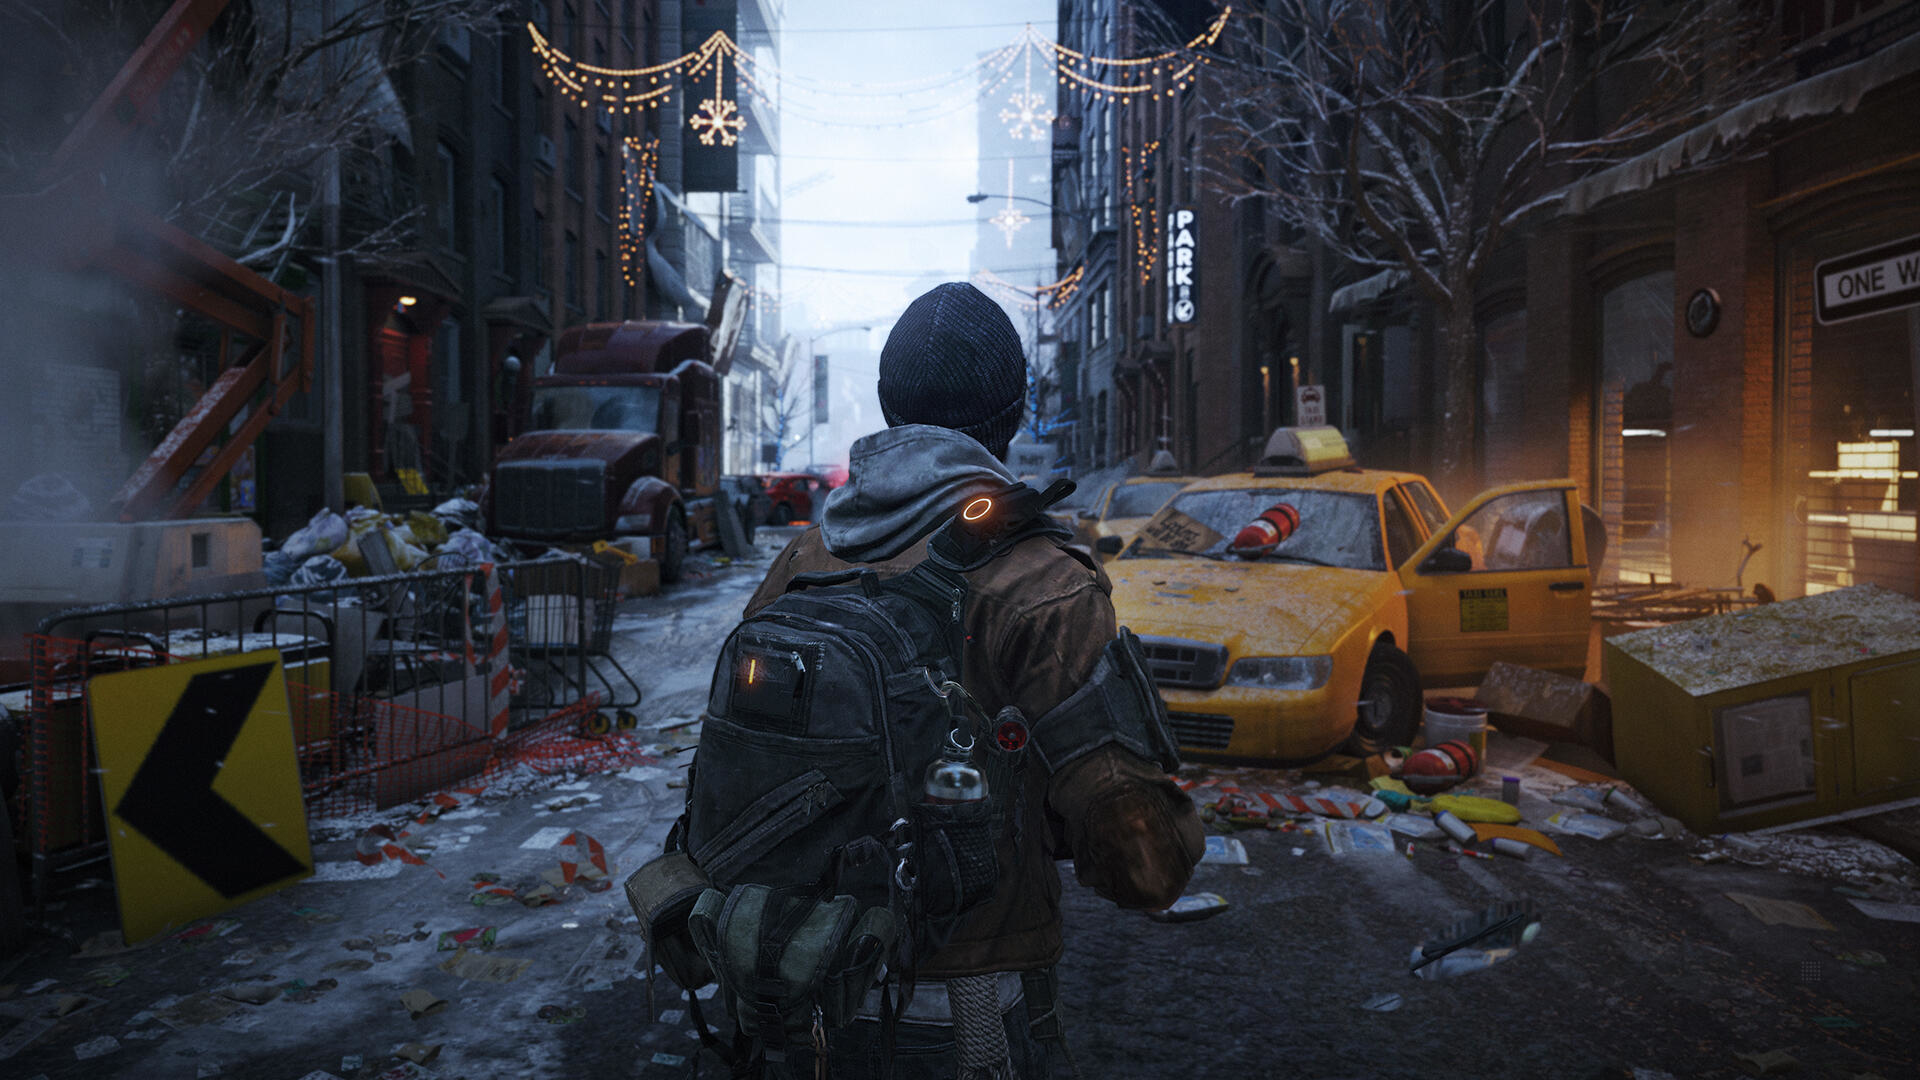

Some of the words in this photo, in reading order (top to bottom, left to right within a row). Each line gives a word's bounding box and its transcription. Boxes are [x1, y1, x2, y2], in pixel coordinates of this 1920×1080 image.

[1175, 209, 1196, 286] PARK
[1838, 265, 1886, 299] ONE
[1896, 255, 1920, 286] W
